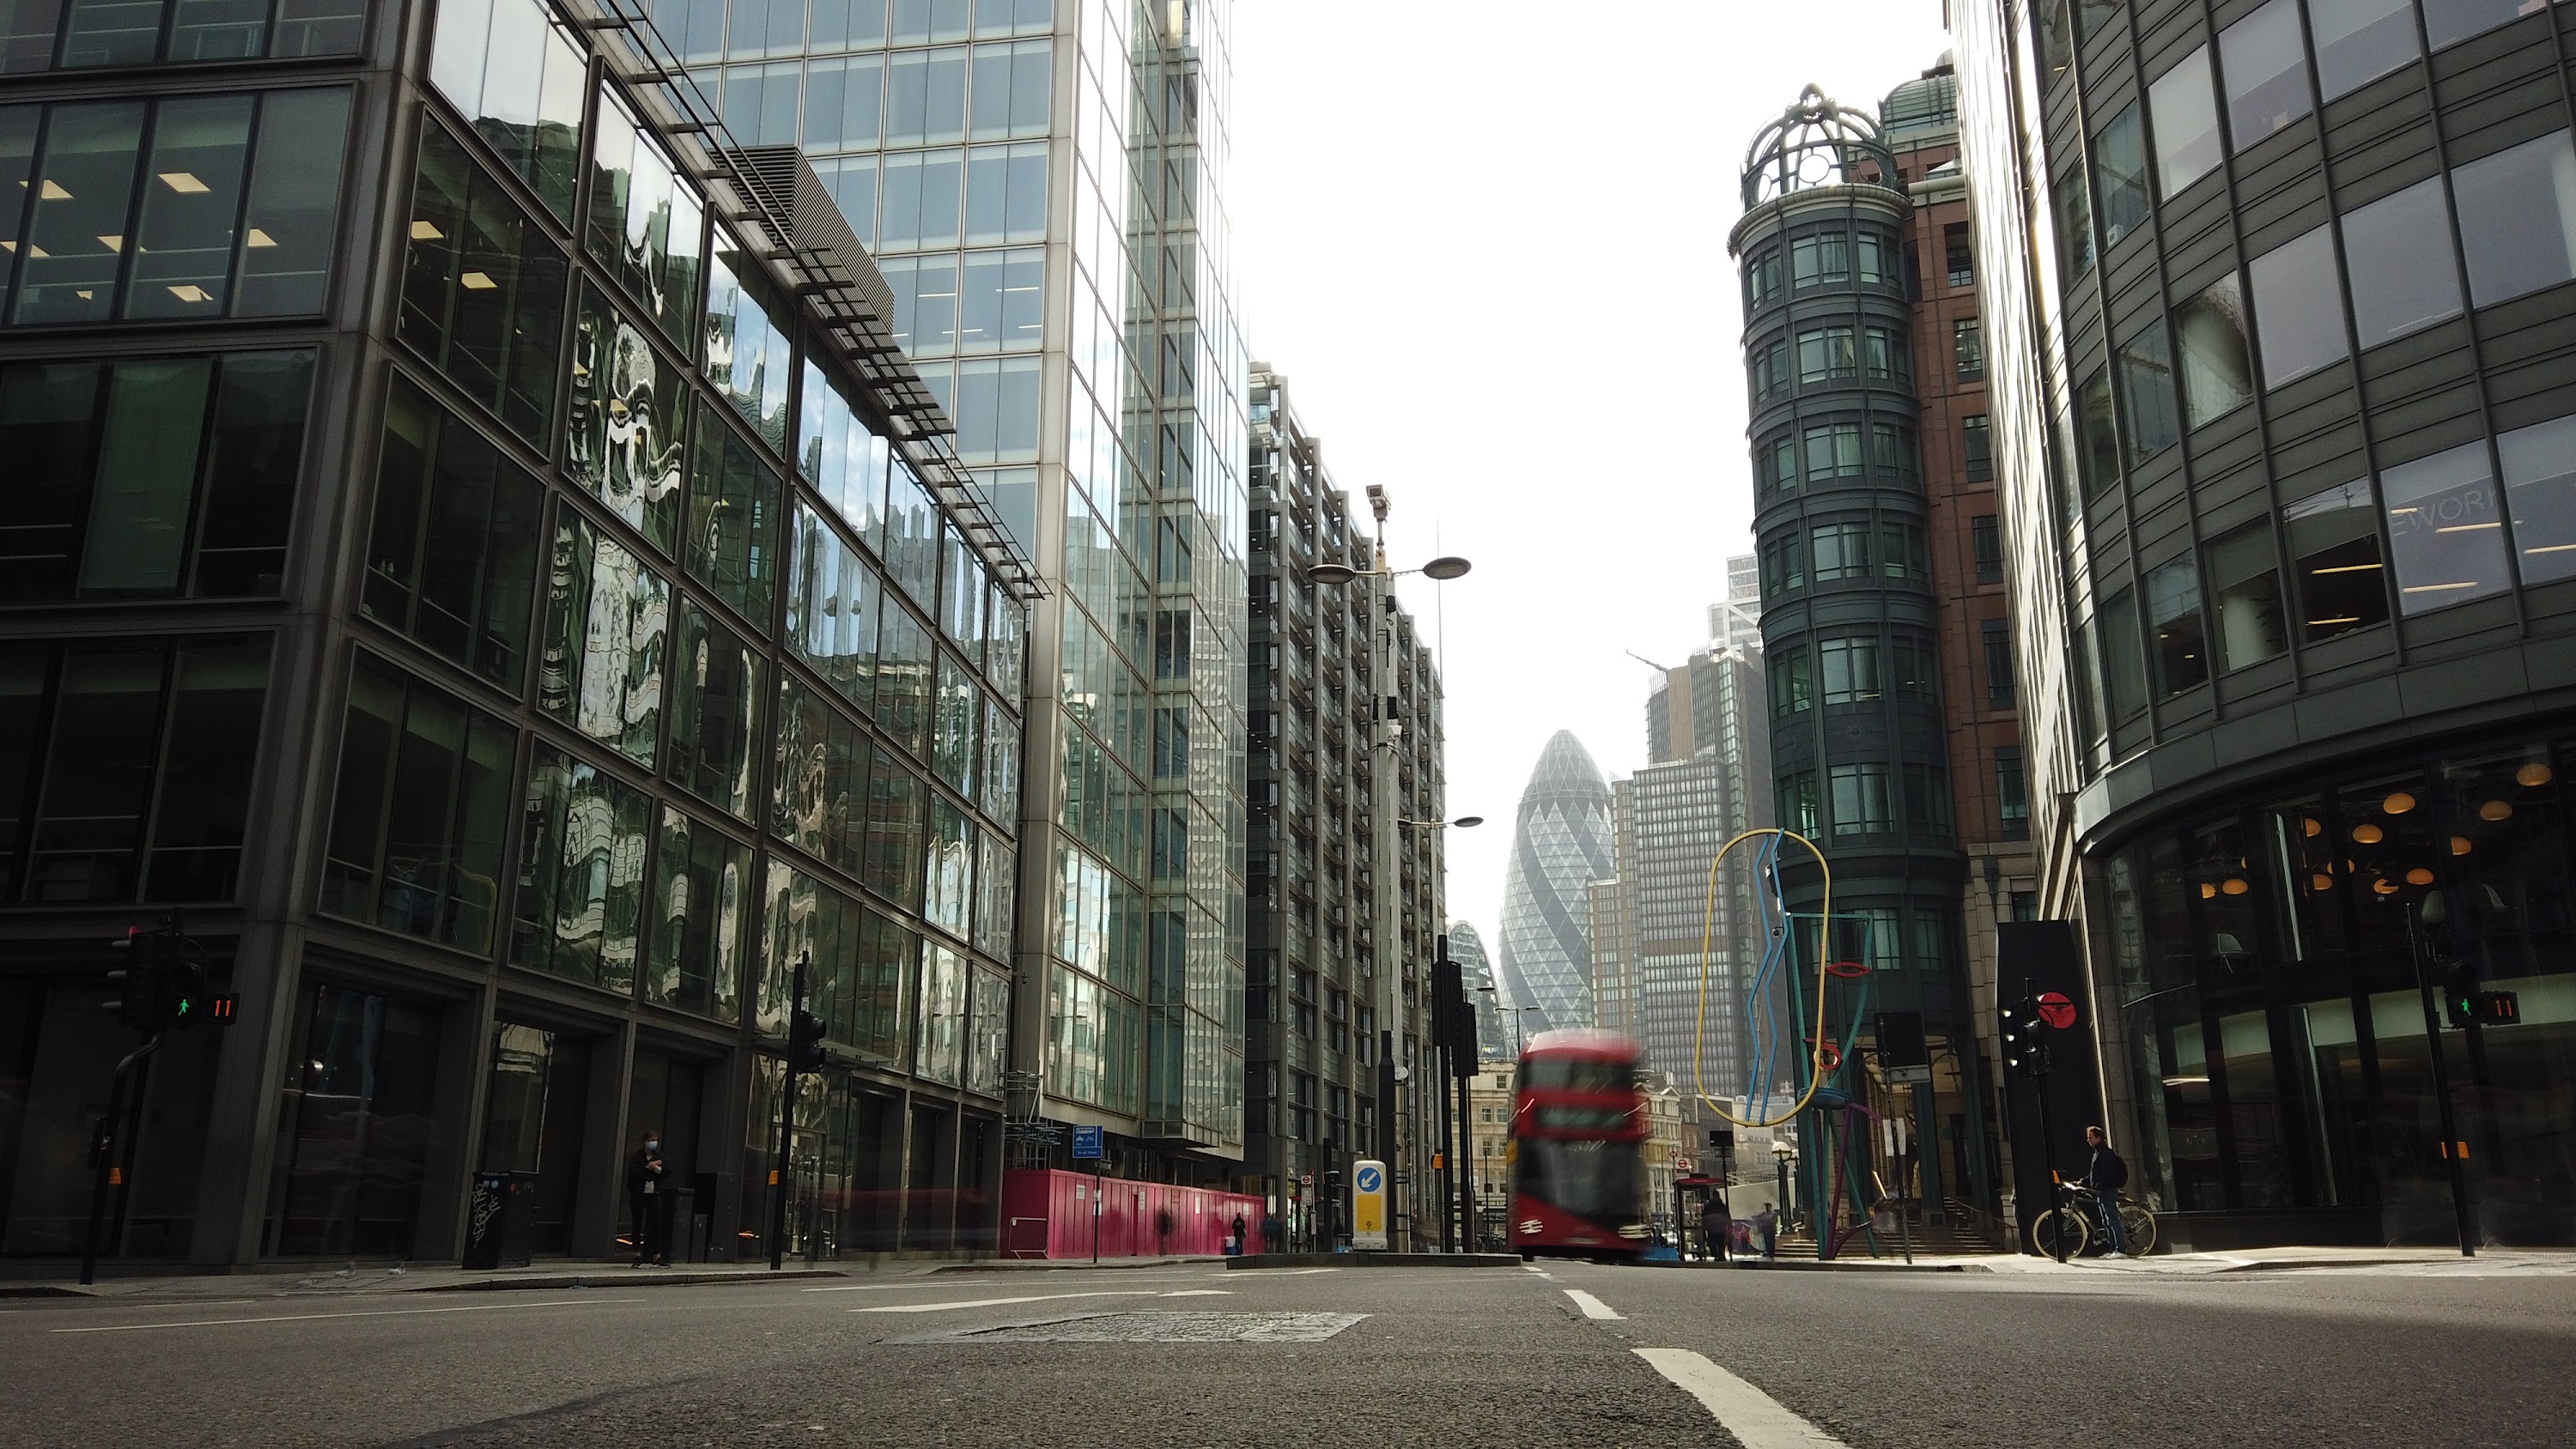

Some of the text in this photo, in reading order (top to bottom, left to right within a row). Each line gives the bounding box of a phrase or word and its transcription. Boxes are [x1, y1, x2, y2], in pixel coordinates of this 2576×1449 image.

[2364, 487, 2497, 547] EWORK
[215, 999, 231, 1016] 11
[2495, 999, 2512, 1016] 11
